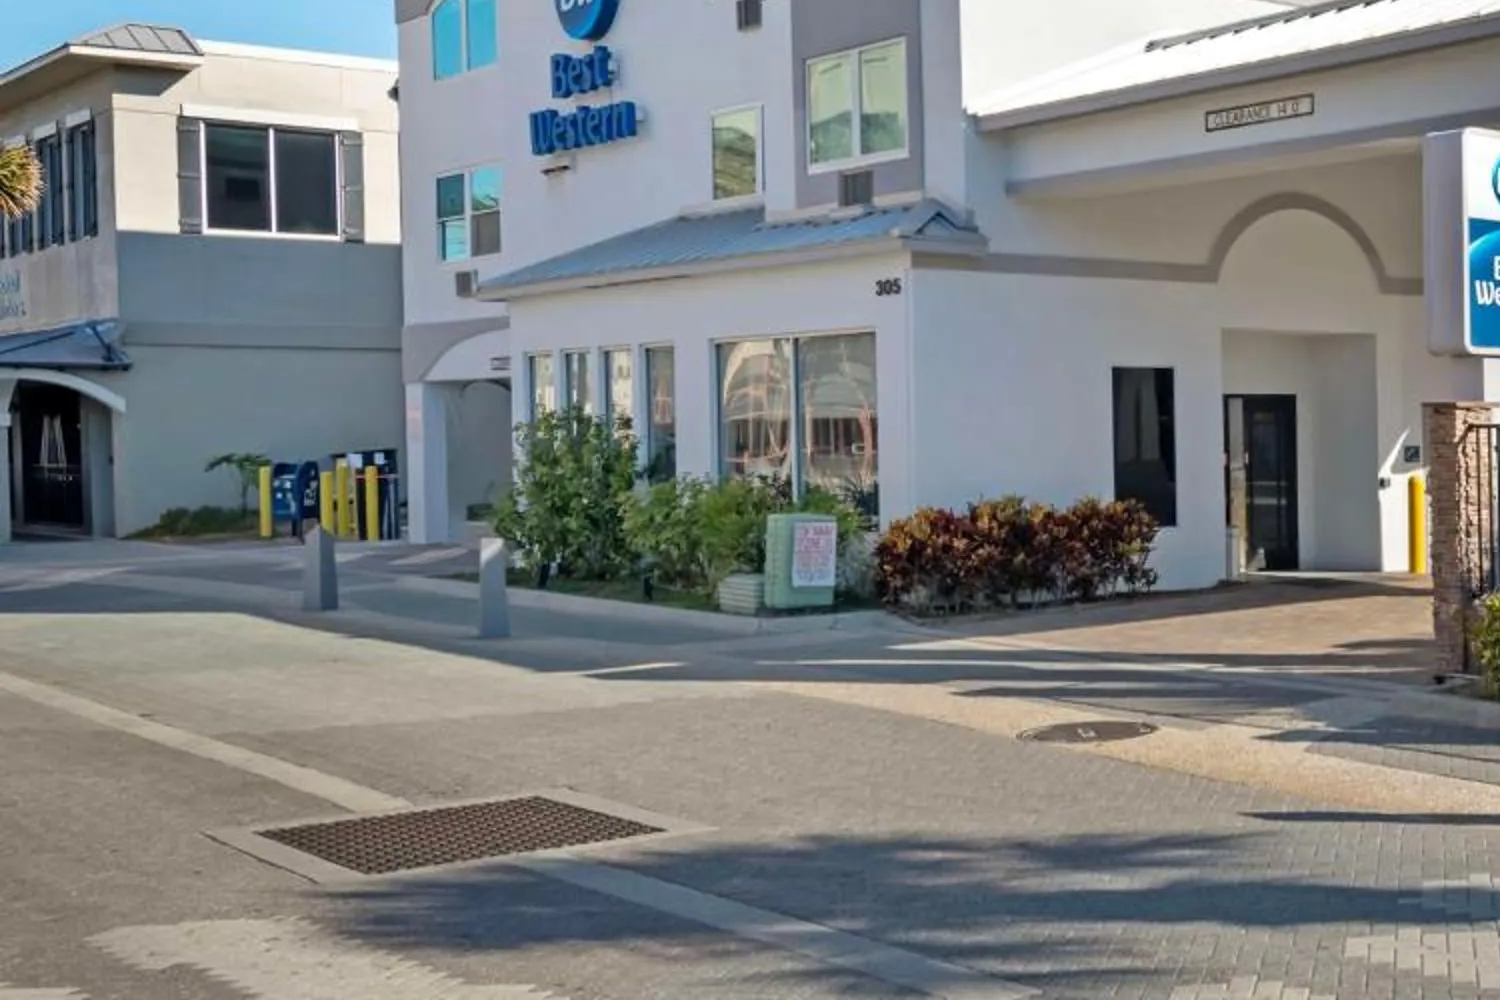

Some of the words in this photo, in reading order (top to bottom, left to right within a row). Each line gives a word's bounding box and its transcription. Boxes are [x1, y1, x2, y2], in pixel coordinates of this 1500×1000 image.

[551, 46, 613, 98] Best
[530, 101, 637, 155] Western
[875, 277, 902, 297] 305
